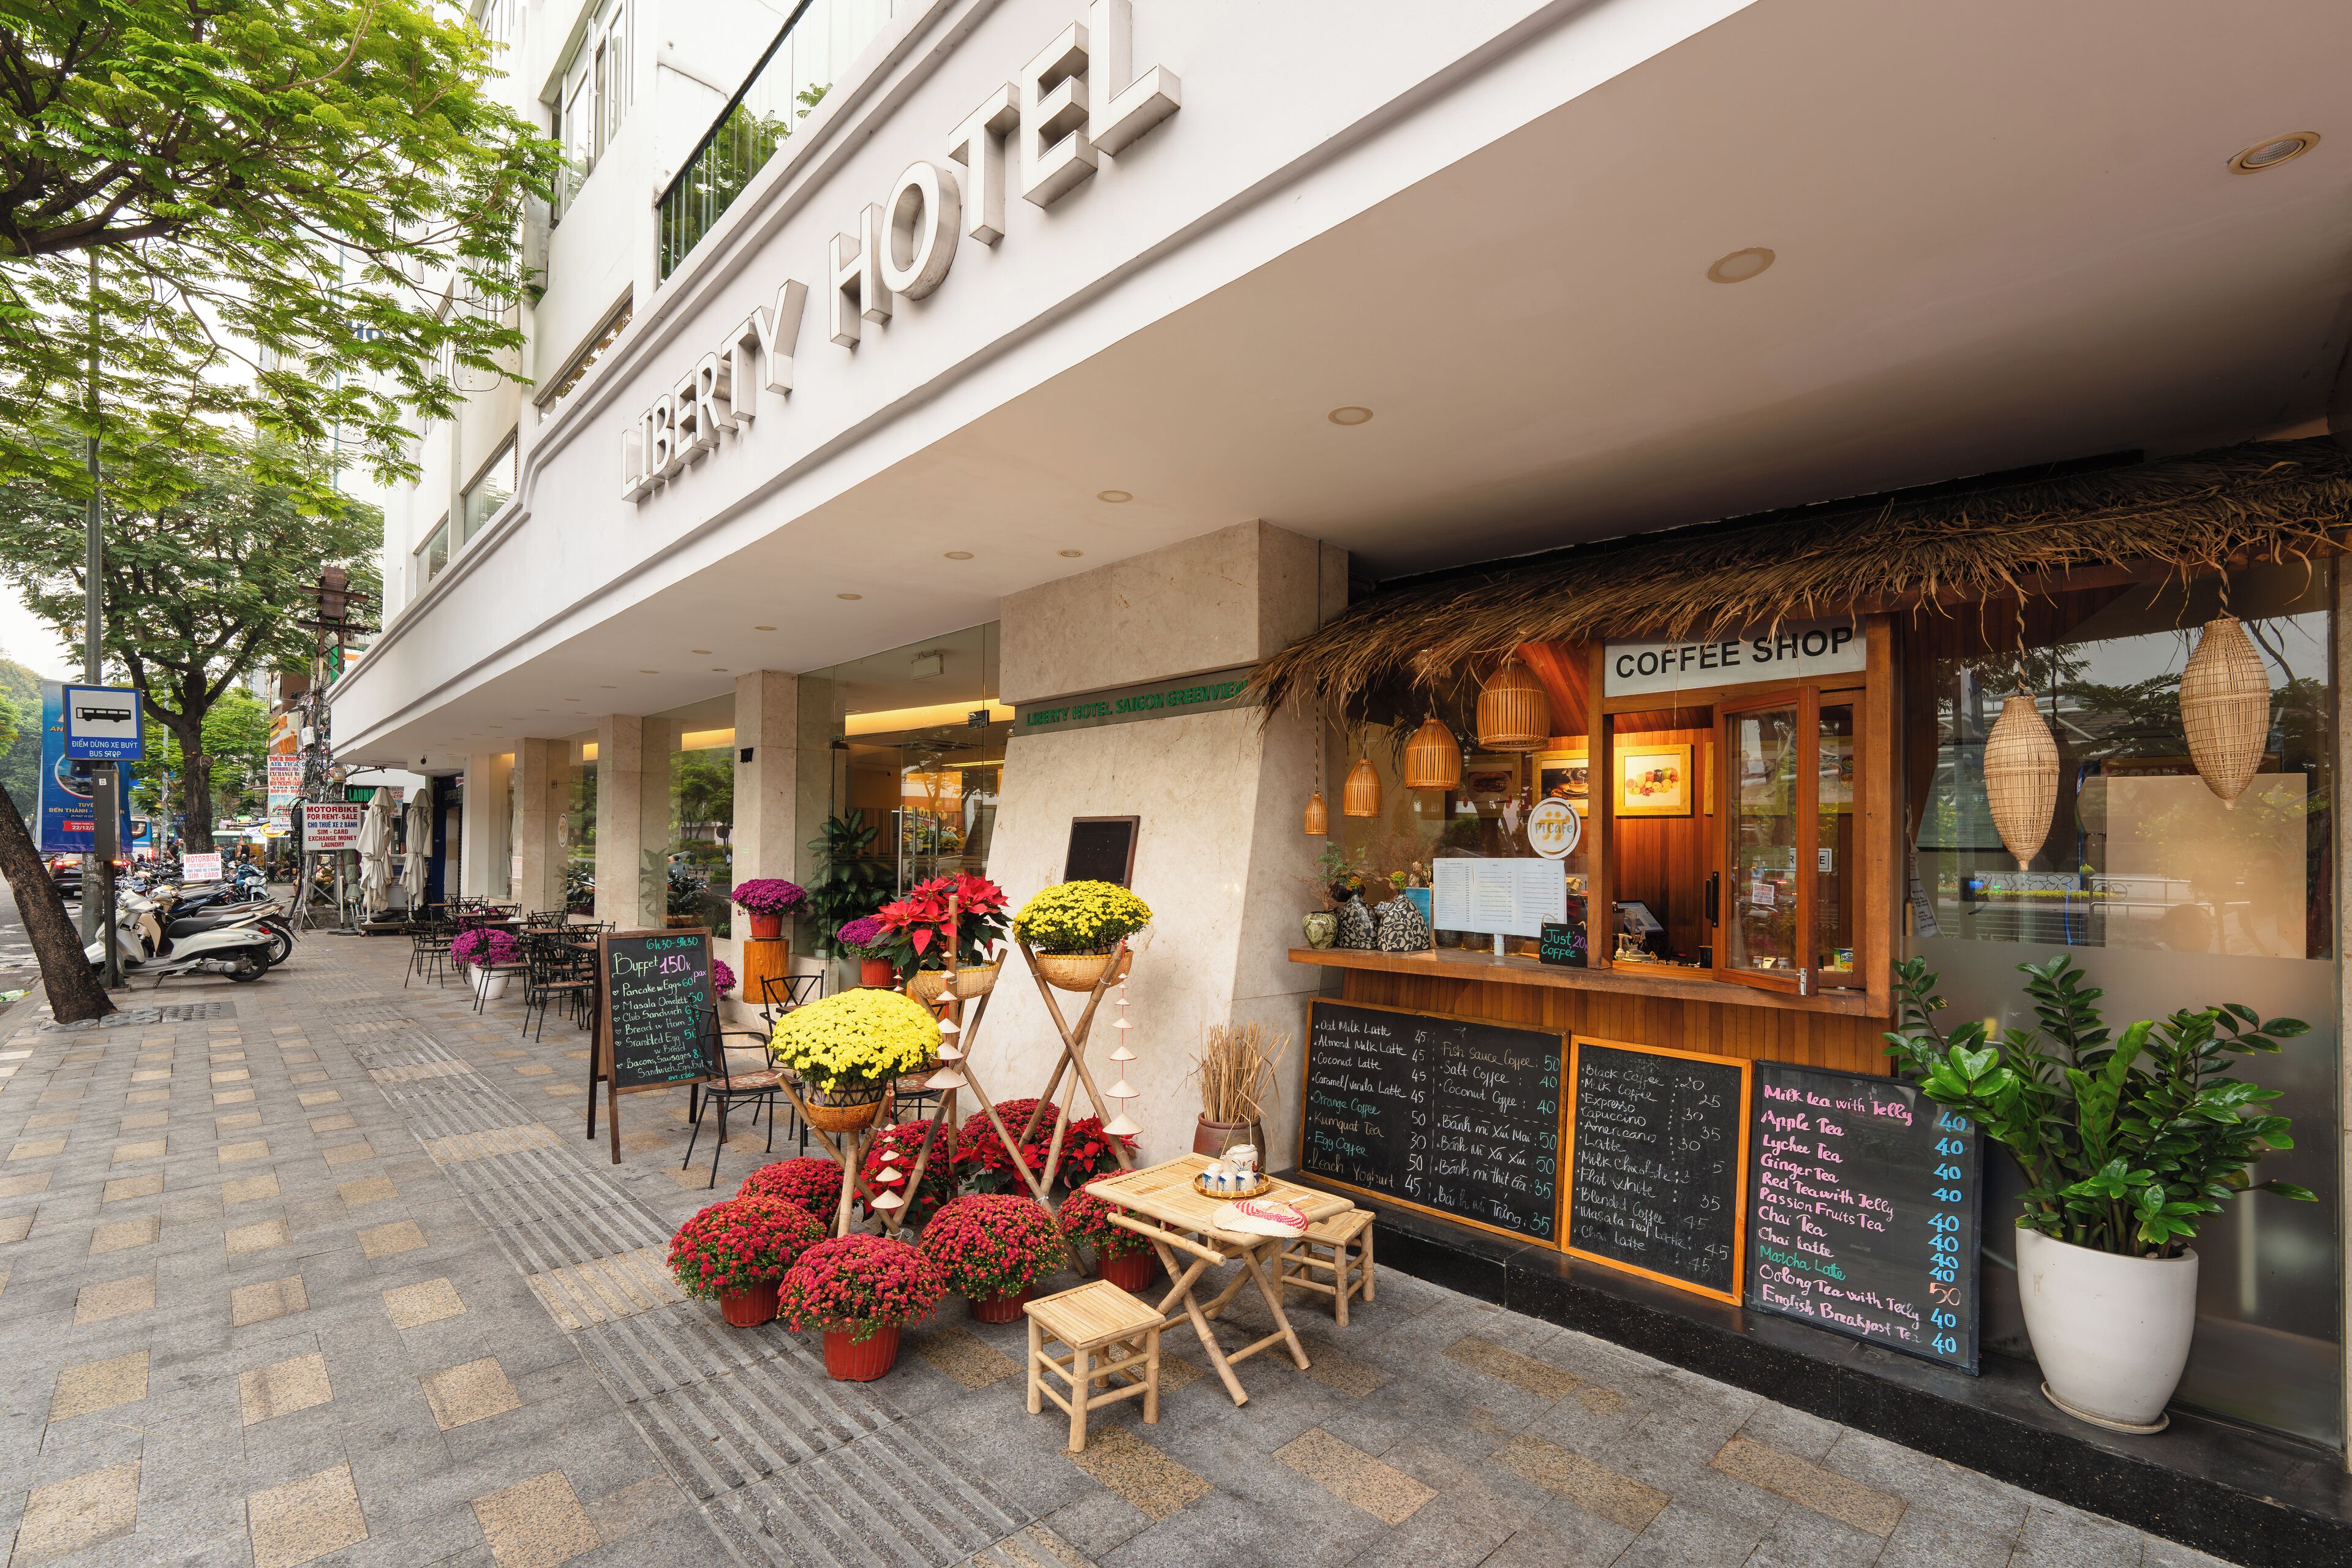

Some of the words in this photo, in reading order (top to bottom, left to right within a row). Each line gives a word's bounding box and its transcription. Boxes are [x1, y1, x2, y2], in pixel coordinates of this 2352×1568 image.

[622, 279, 808, 502] LIBERTY
[830, 0, 1180, 349] HOTEL
[1616, 641, 1740, 677] COFFEE
[1752, 627, 1853, 662] SHOP
[1027, 707, 1069, 726] LIBERTY
[1072, 702, 1112, 720] HOTEL
[1115, 693, 1163, 714] SAIGON
[72, 739, 88, 747] ĐIỂM
[1544, 930, 1571, 946] Just
[623, 983, 656, 997] Pancake
[663, 979, 681, 995] Eggs
[682, 978, 693, 987] 60
[694, 970, 706, 983] pax
[623, 998, 655, 1010] Masala
[658, 995, 688, 1006] Omelett
[623, 1012, 640, 1022] Club
[643, 1006, 682, 1019] Sandwich
[625, 1022, 653, 1035] Bread
[666, 1019, 685, 1028] Ham
[665, 1032, 680, 1047] Egg
[1321, 1020, 1335, 1030] Oat
[1340, 1020, 1360, 1033] Milk
[1365, 1023, 1391, 1036] Latte
[1415, 1030, 1428, 1044] 45
[663, 1042, 685, 1054] Bread
[1318, 1035, 1351, 1049] Almond
[1380, 1042, 1406, 1055] Latte
[1412, 1049, 1425, 1062] 45
[1442, 1041, 1464, 1057] Fish
[1544, 1055, 1559, 1071] 50
[1318, 1052, 1352, 1066] Coconut
[1359, 1057, 1382, 1069] Latte
[1412, 1069, 1426, 1082] 45
[1444, 1061, 1469, 1076] Salt
[1474, 1066, 1509, 1087] Coffee
[1539, 1076, 1557, 1087] 40
[1351, 1098, 1381, 1118] Coffee
[1412, 1110, 1425, 1126] 50
[1582, 1106, 1646, 1126] Capuccino
[1585, 1093, 1635, 1112] Expresso
[1836, 1098, 1865, 1112] with
[1939, 1112, 1966, 1133] 40
[1314, 1111, 1359, 1133] Kumquat
[1364, 1121, 1384, 1137] Tea
[1411, 1132, 1426, 1150] 30
[1585, 1121, 1656, 1142] Americano
[1678, 1139, 1700, 1150] 30
[1585, 1133, 1626, 1152] Latte
[1761, 1110, 1811, 1132] Apple
[1816, 1118, 1844, 1136] Tea
[1935, 1137, 1964, 1156] 40
[1315, 1131, 1333, 1151] Egg
[1407, 1154, 1422, 1171] 50
[1763, 1134, 1811, 1155] Lychee
[1817, 1143, 1842, 1163] Tea
[1934, 1164, 1961, 1180] 40
[1761, 1153, 1812, 1180] Ginger
[1814, 1168, 1839, 1183] Tea
[1931, 1188, 1962, 1202] 40
[1762, 1172, 1789, 1190] Red
[1793, 1180, 1819, 1197] Tea
[1819, 1188, 1854, 1205] with
[1858, 1194, 1894, 1222] Jelly
[1928, 1212, 1959, 1232] 40
[1760, 1187, 1812, 1212] Passion
[1815, 1202, 1855, 1225] Fruits
[1856, 1213, 1885, 1232] Tea
[1928, 1234, 1959, 1253] 40
[1758, 1205, 1792, 1226] Chai
[1796, 1214, 1828, 1237] Tea
[1929, 1253, 1959, 1269] 40
[1758, 1227, 1789, 1245] Chai
[1797, 1236, 1834, 1257] Latte
[1929, 1265, 1955, 1283] 40
[1760, 1245, 1811, 1271] Matcha
[1815, 1259, 1846, 1281] Latte
[1929, 1282, 1961, 1306] 50
[1760, 1264, 1812, 1295] Oolong
[1813, 1280, 1844, 1297] Tea
[1847, 1292, 1883, 1309] with
[1931, 1308, 1957, 1329] 40
[1763, 1284, 1814, 1316] English
[1820, 1303, 1891, 1336] Breakfast
[1931, 1333, 1957, 1355] 40
